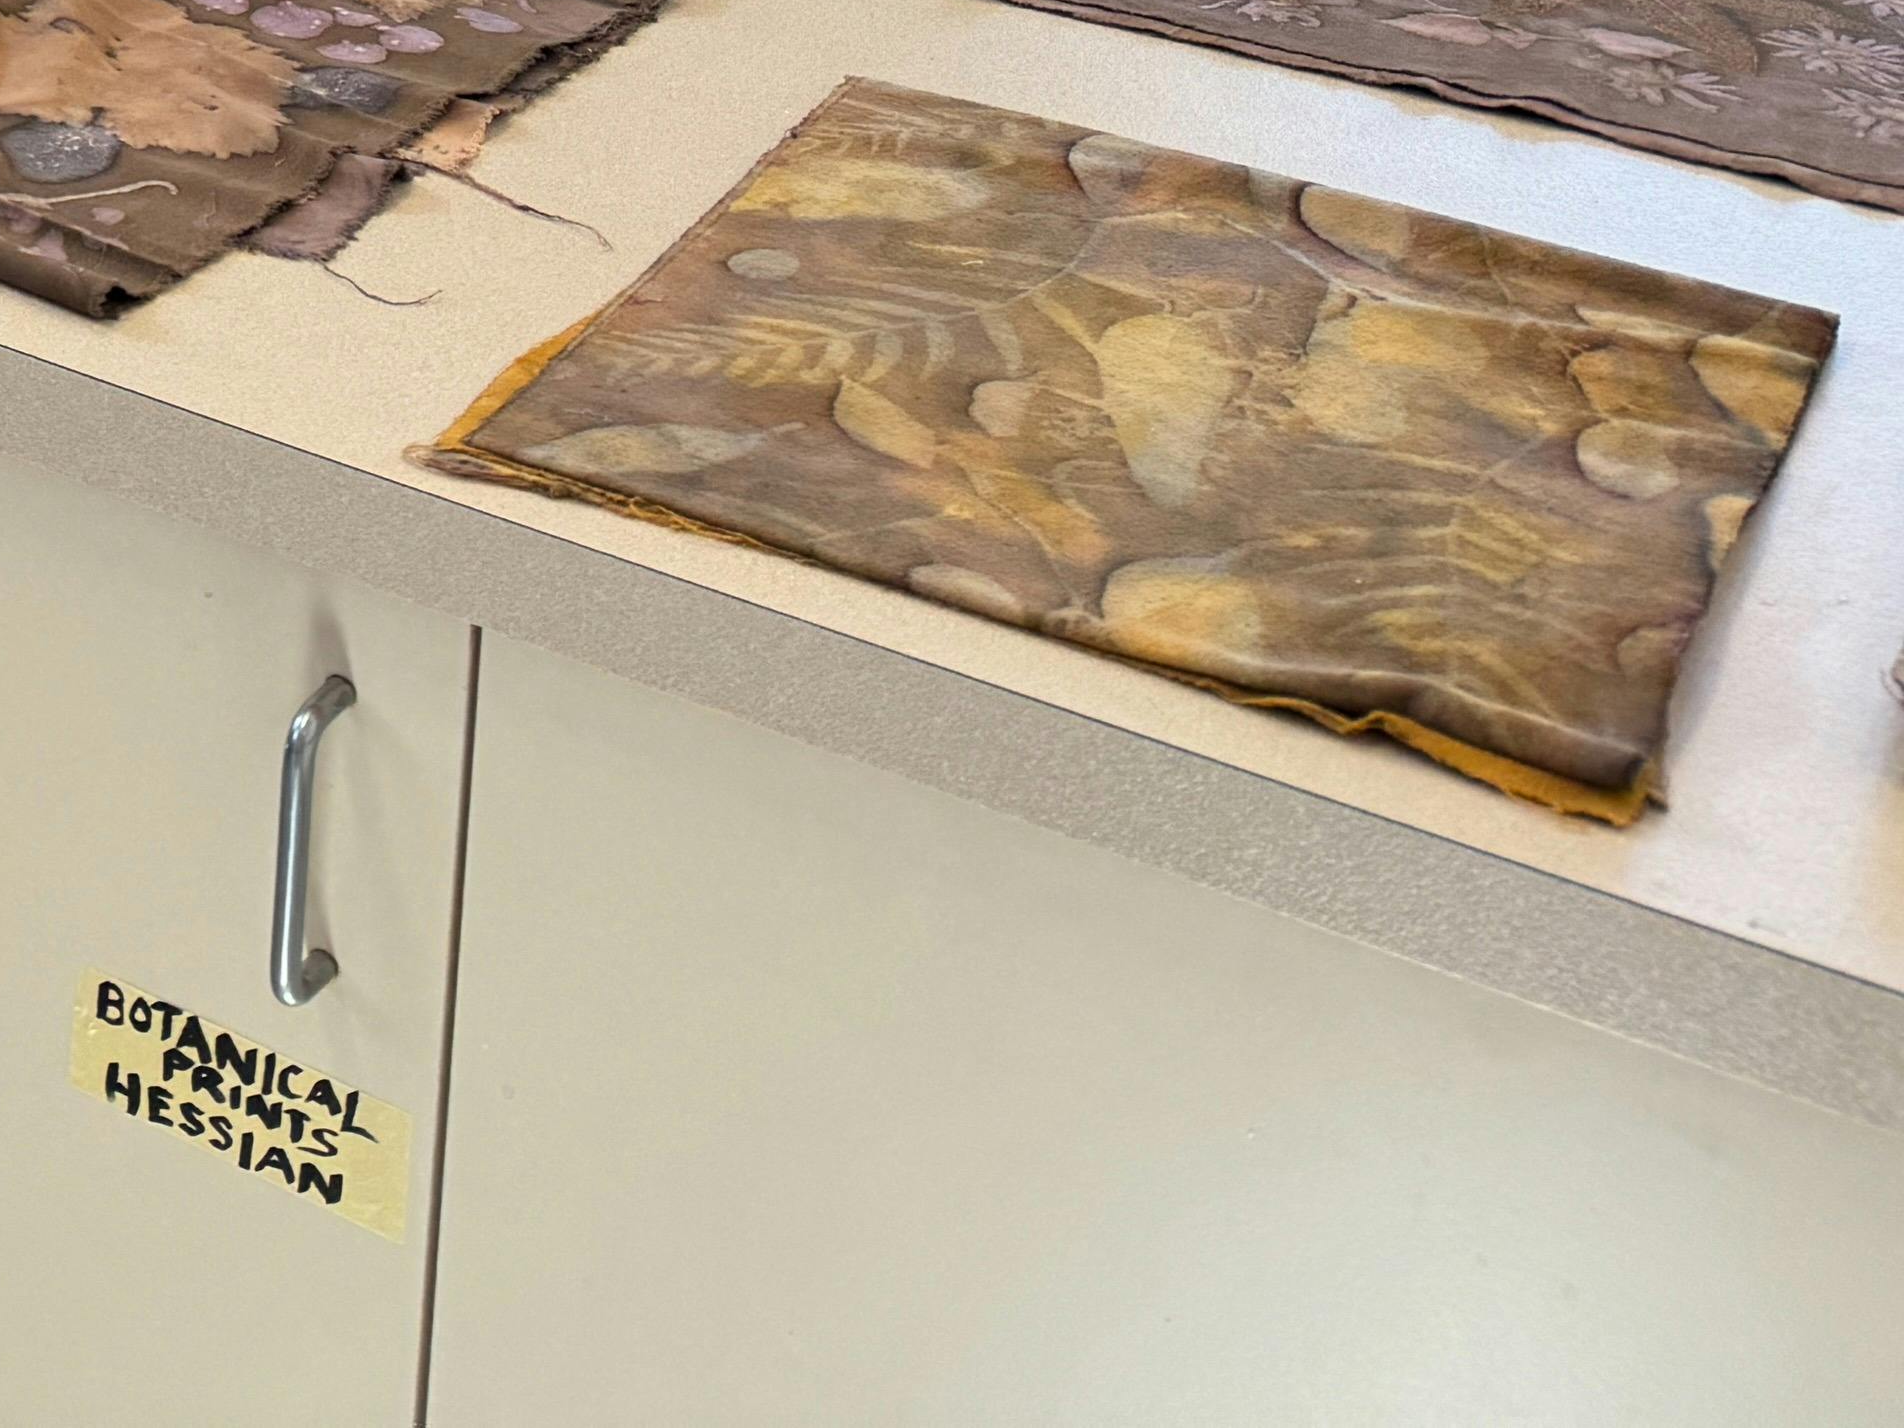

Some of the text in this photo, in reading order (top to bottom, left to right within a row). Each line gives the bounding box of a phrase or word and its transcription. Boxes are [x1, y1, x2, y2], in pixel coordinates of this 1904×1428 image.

[96, 980, 380, 1144] BOTANICAL
[104, 1062, 344, 1205] HESSIAN
[163, 1047, 339, 1158] PRINTS
